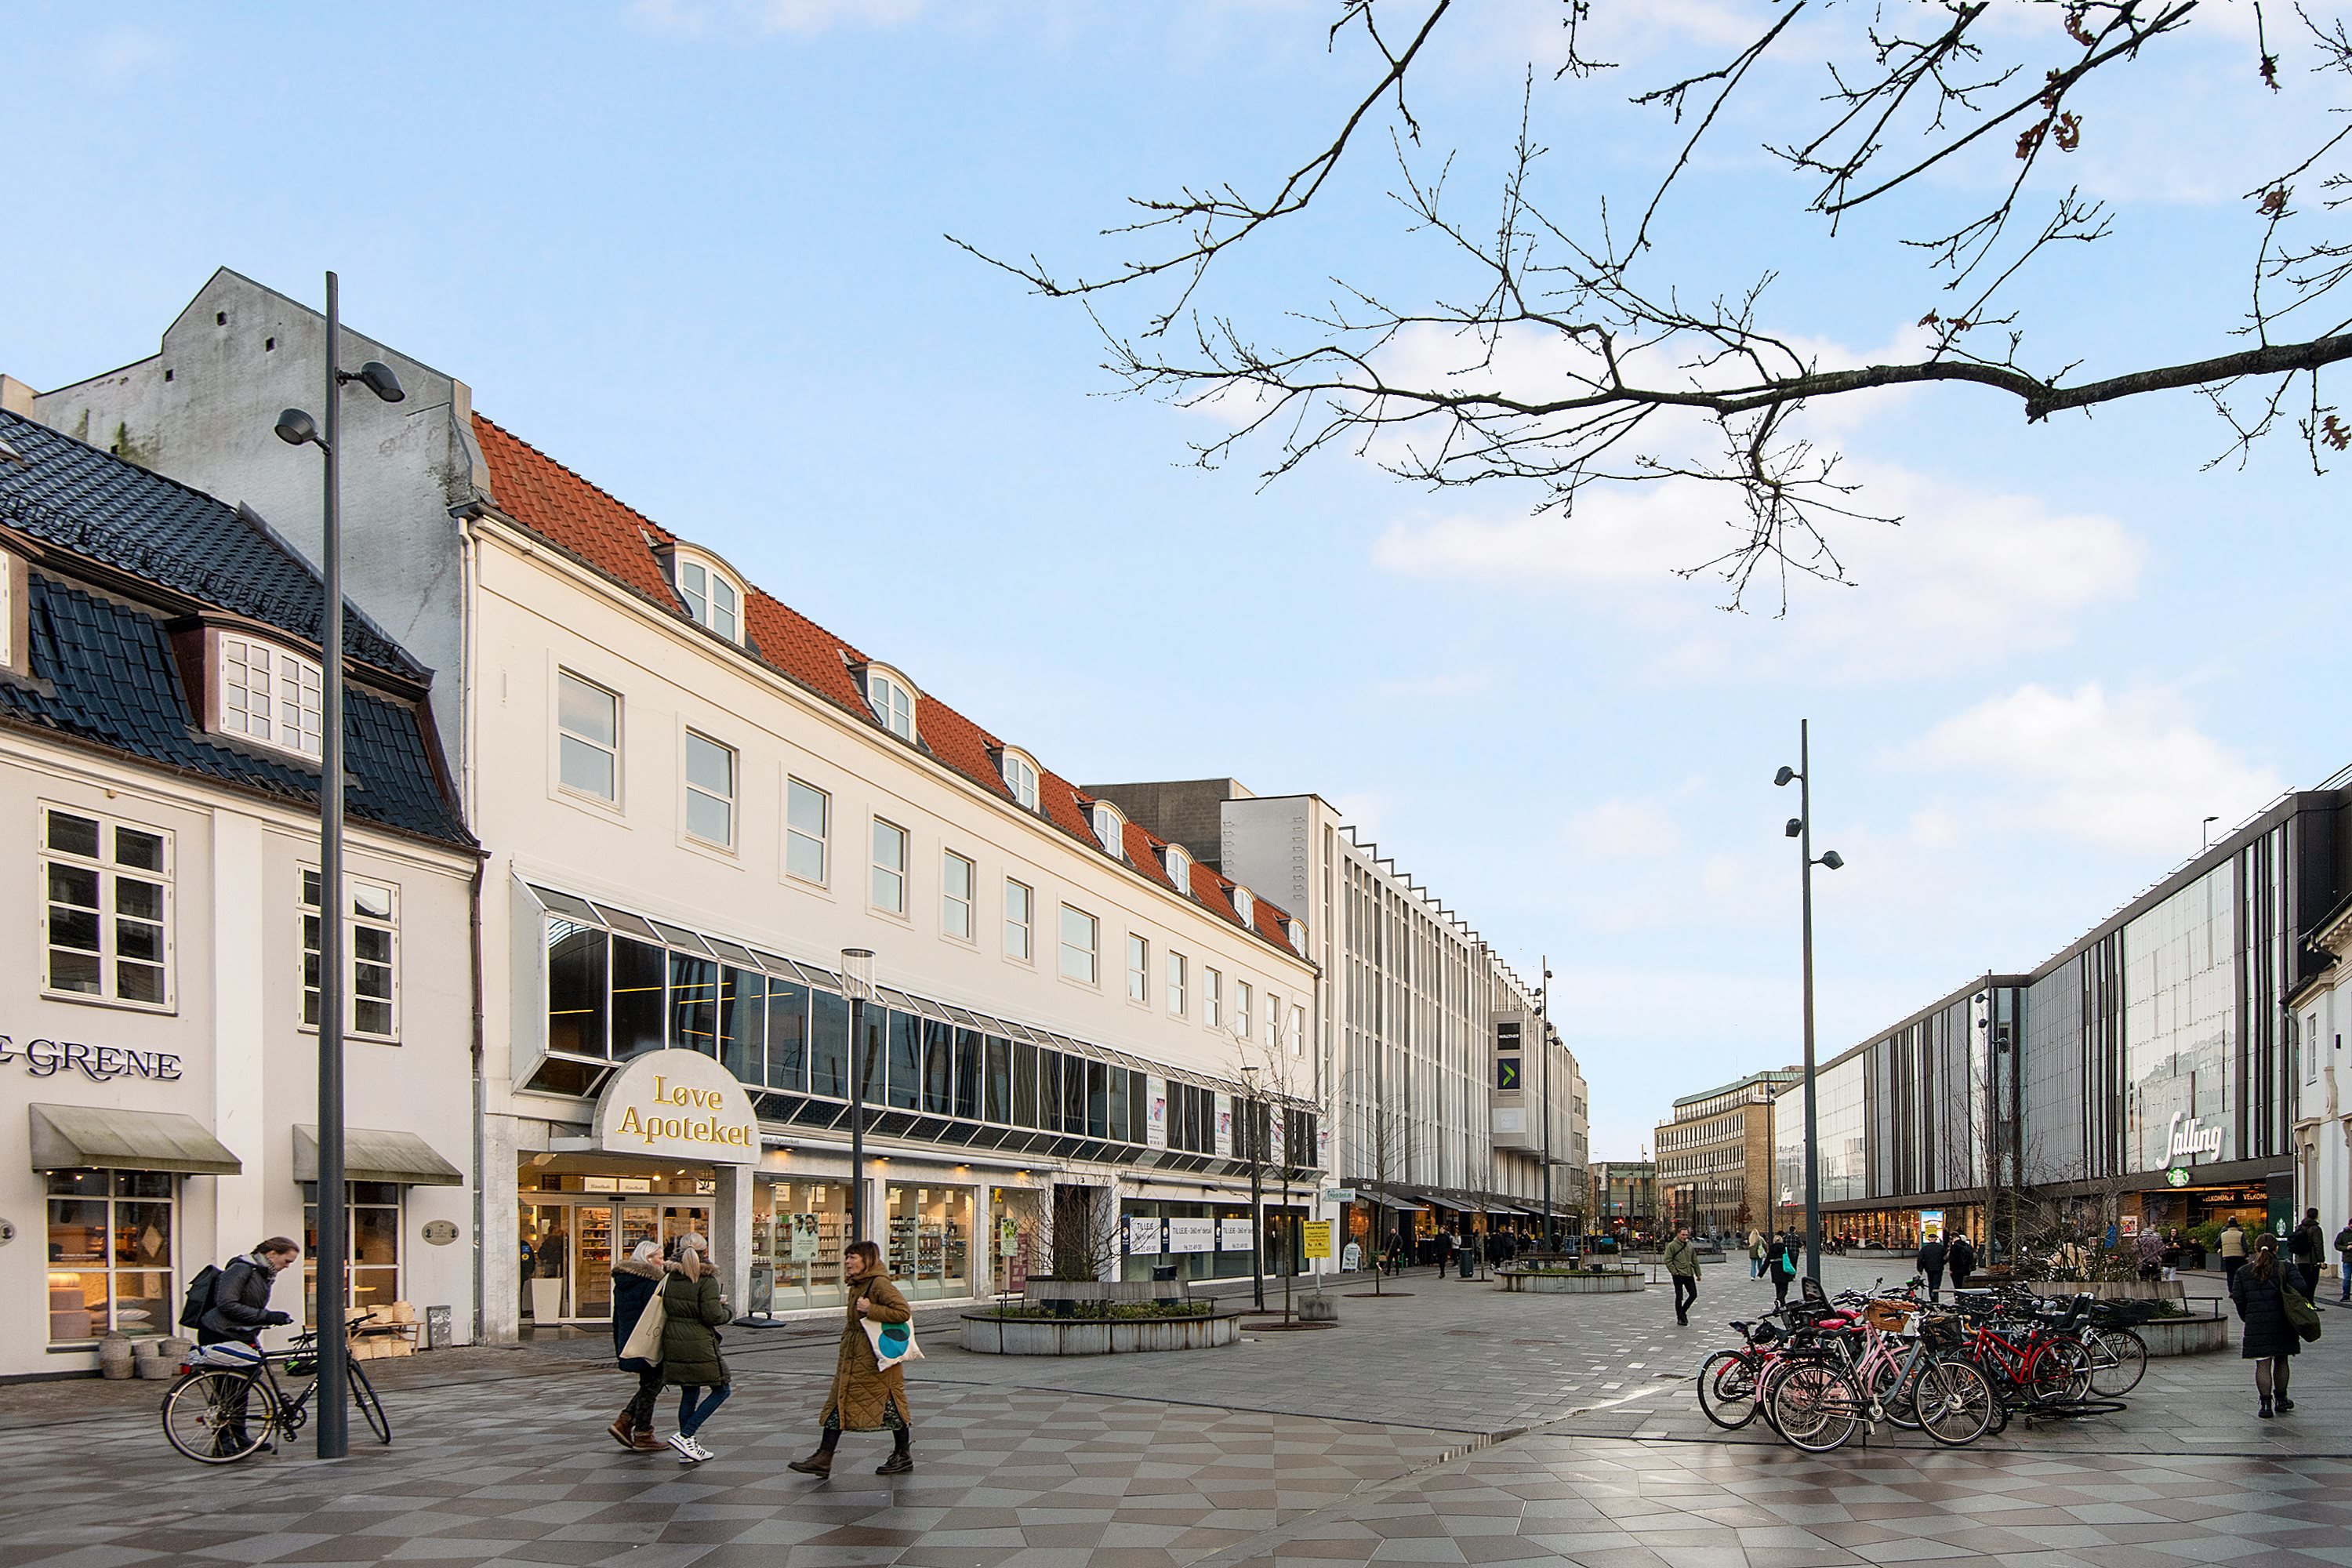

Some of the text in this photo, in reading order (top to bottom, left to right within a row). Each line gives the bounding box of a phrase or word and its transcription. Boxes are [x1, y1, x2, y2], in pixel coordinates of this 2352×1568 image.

[26, 1038, 183, 1082] GRENE
[652, 1075, 723, 1111] Løve
[615, 1105, 753, 1147] Apoteket
[2156, 1110, 2224, 1170] Salling
